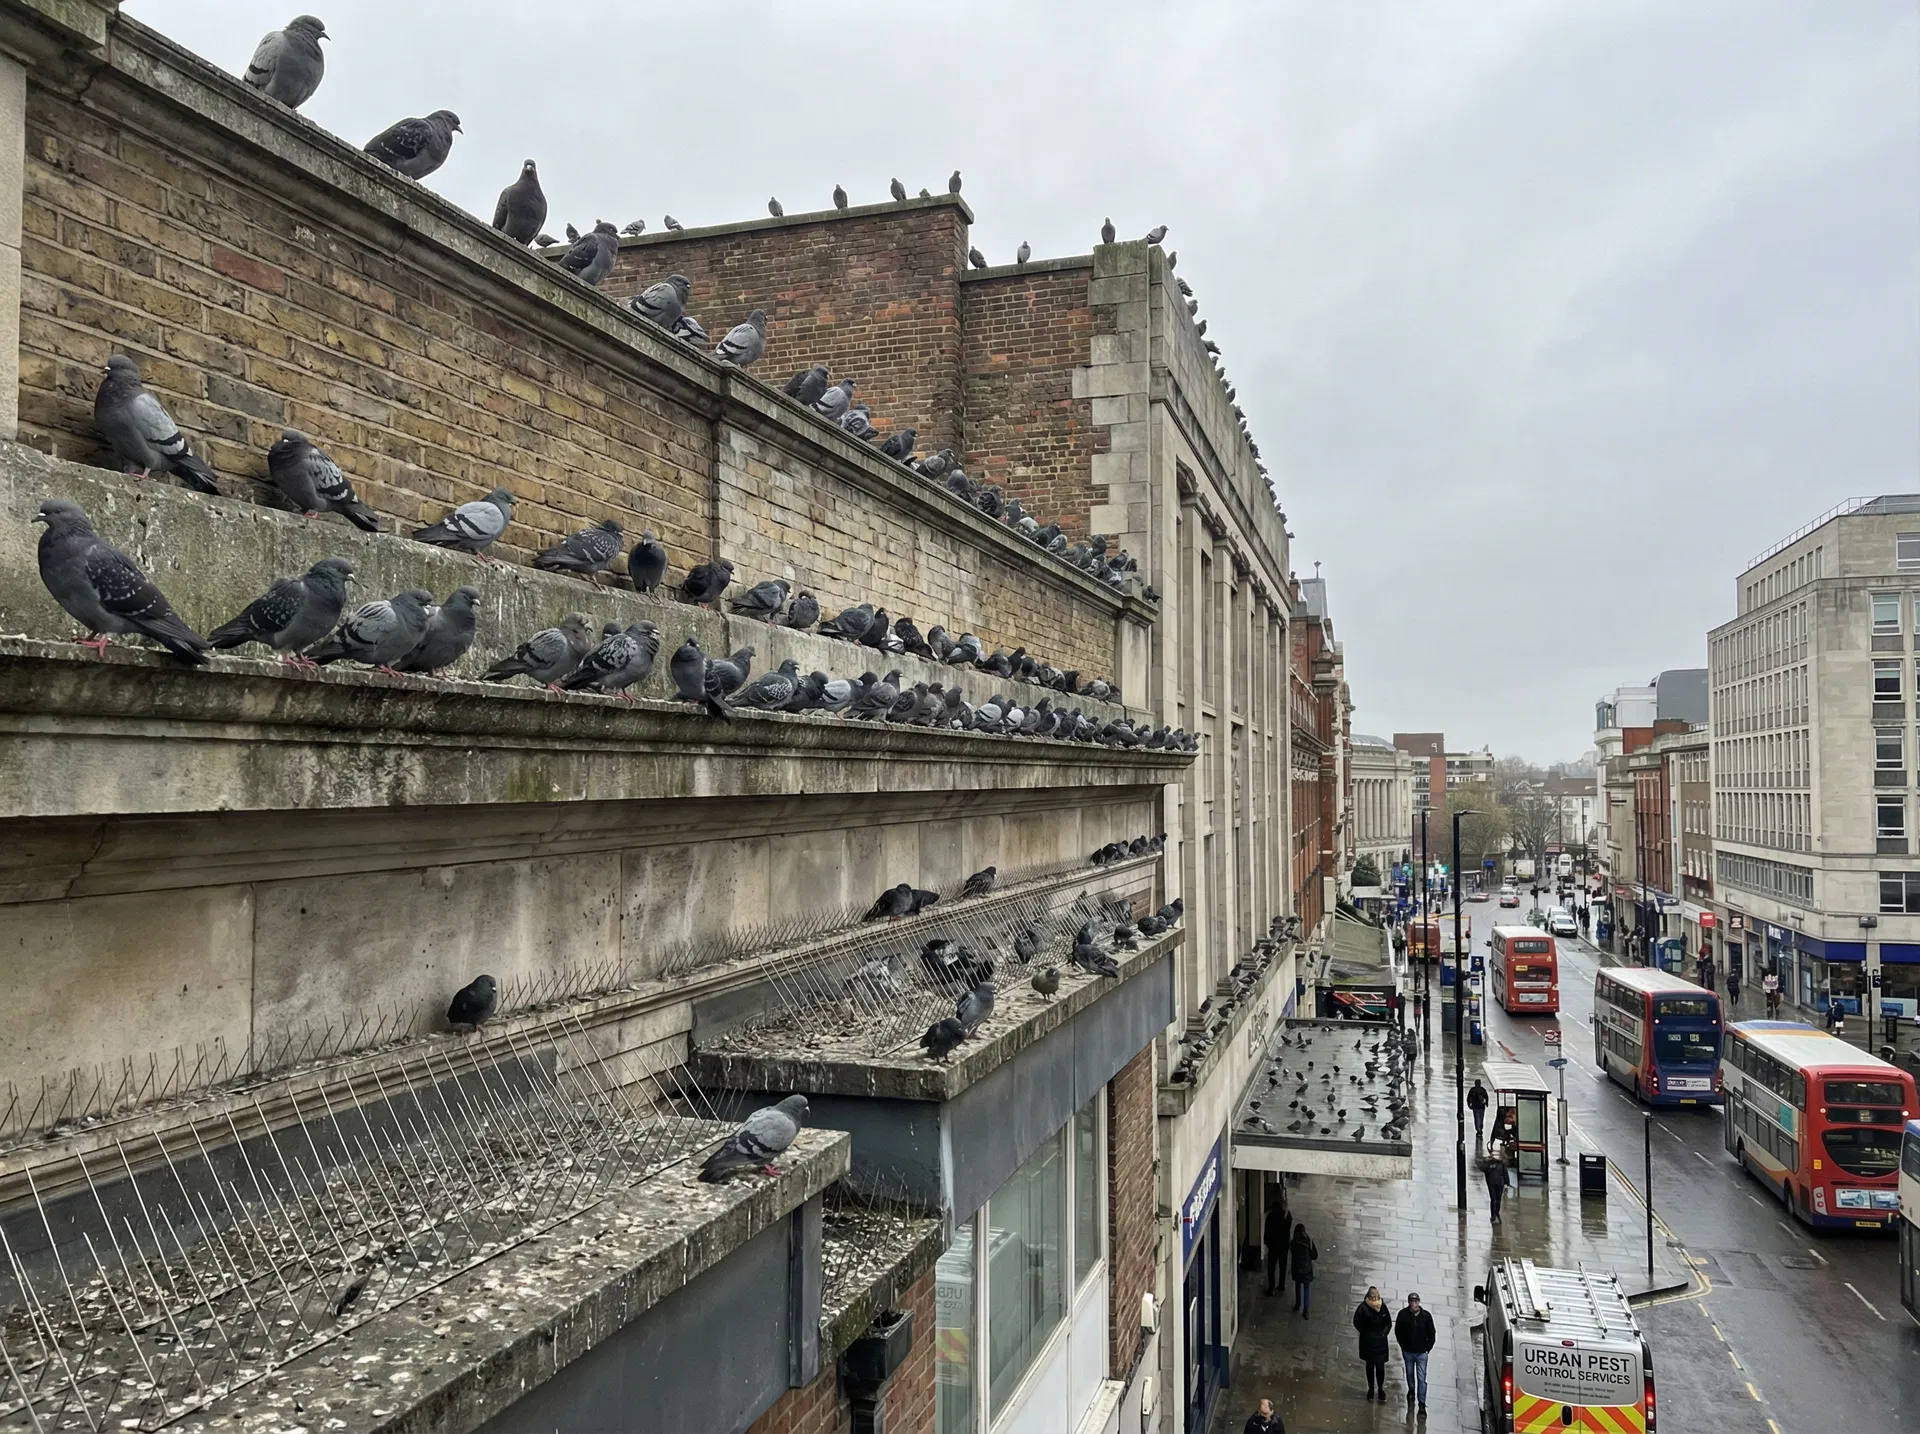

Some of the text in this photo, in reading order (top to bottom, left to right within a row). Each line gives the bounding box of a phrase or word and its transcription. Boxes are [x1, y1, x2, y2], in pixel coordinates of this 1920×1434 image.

[1525, 1348, 1630, 1372] URBAN PEST
[1525, 1365, 1631, 1385] CONTROL SERVICES
